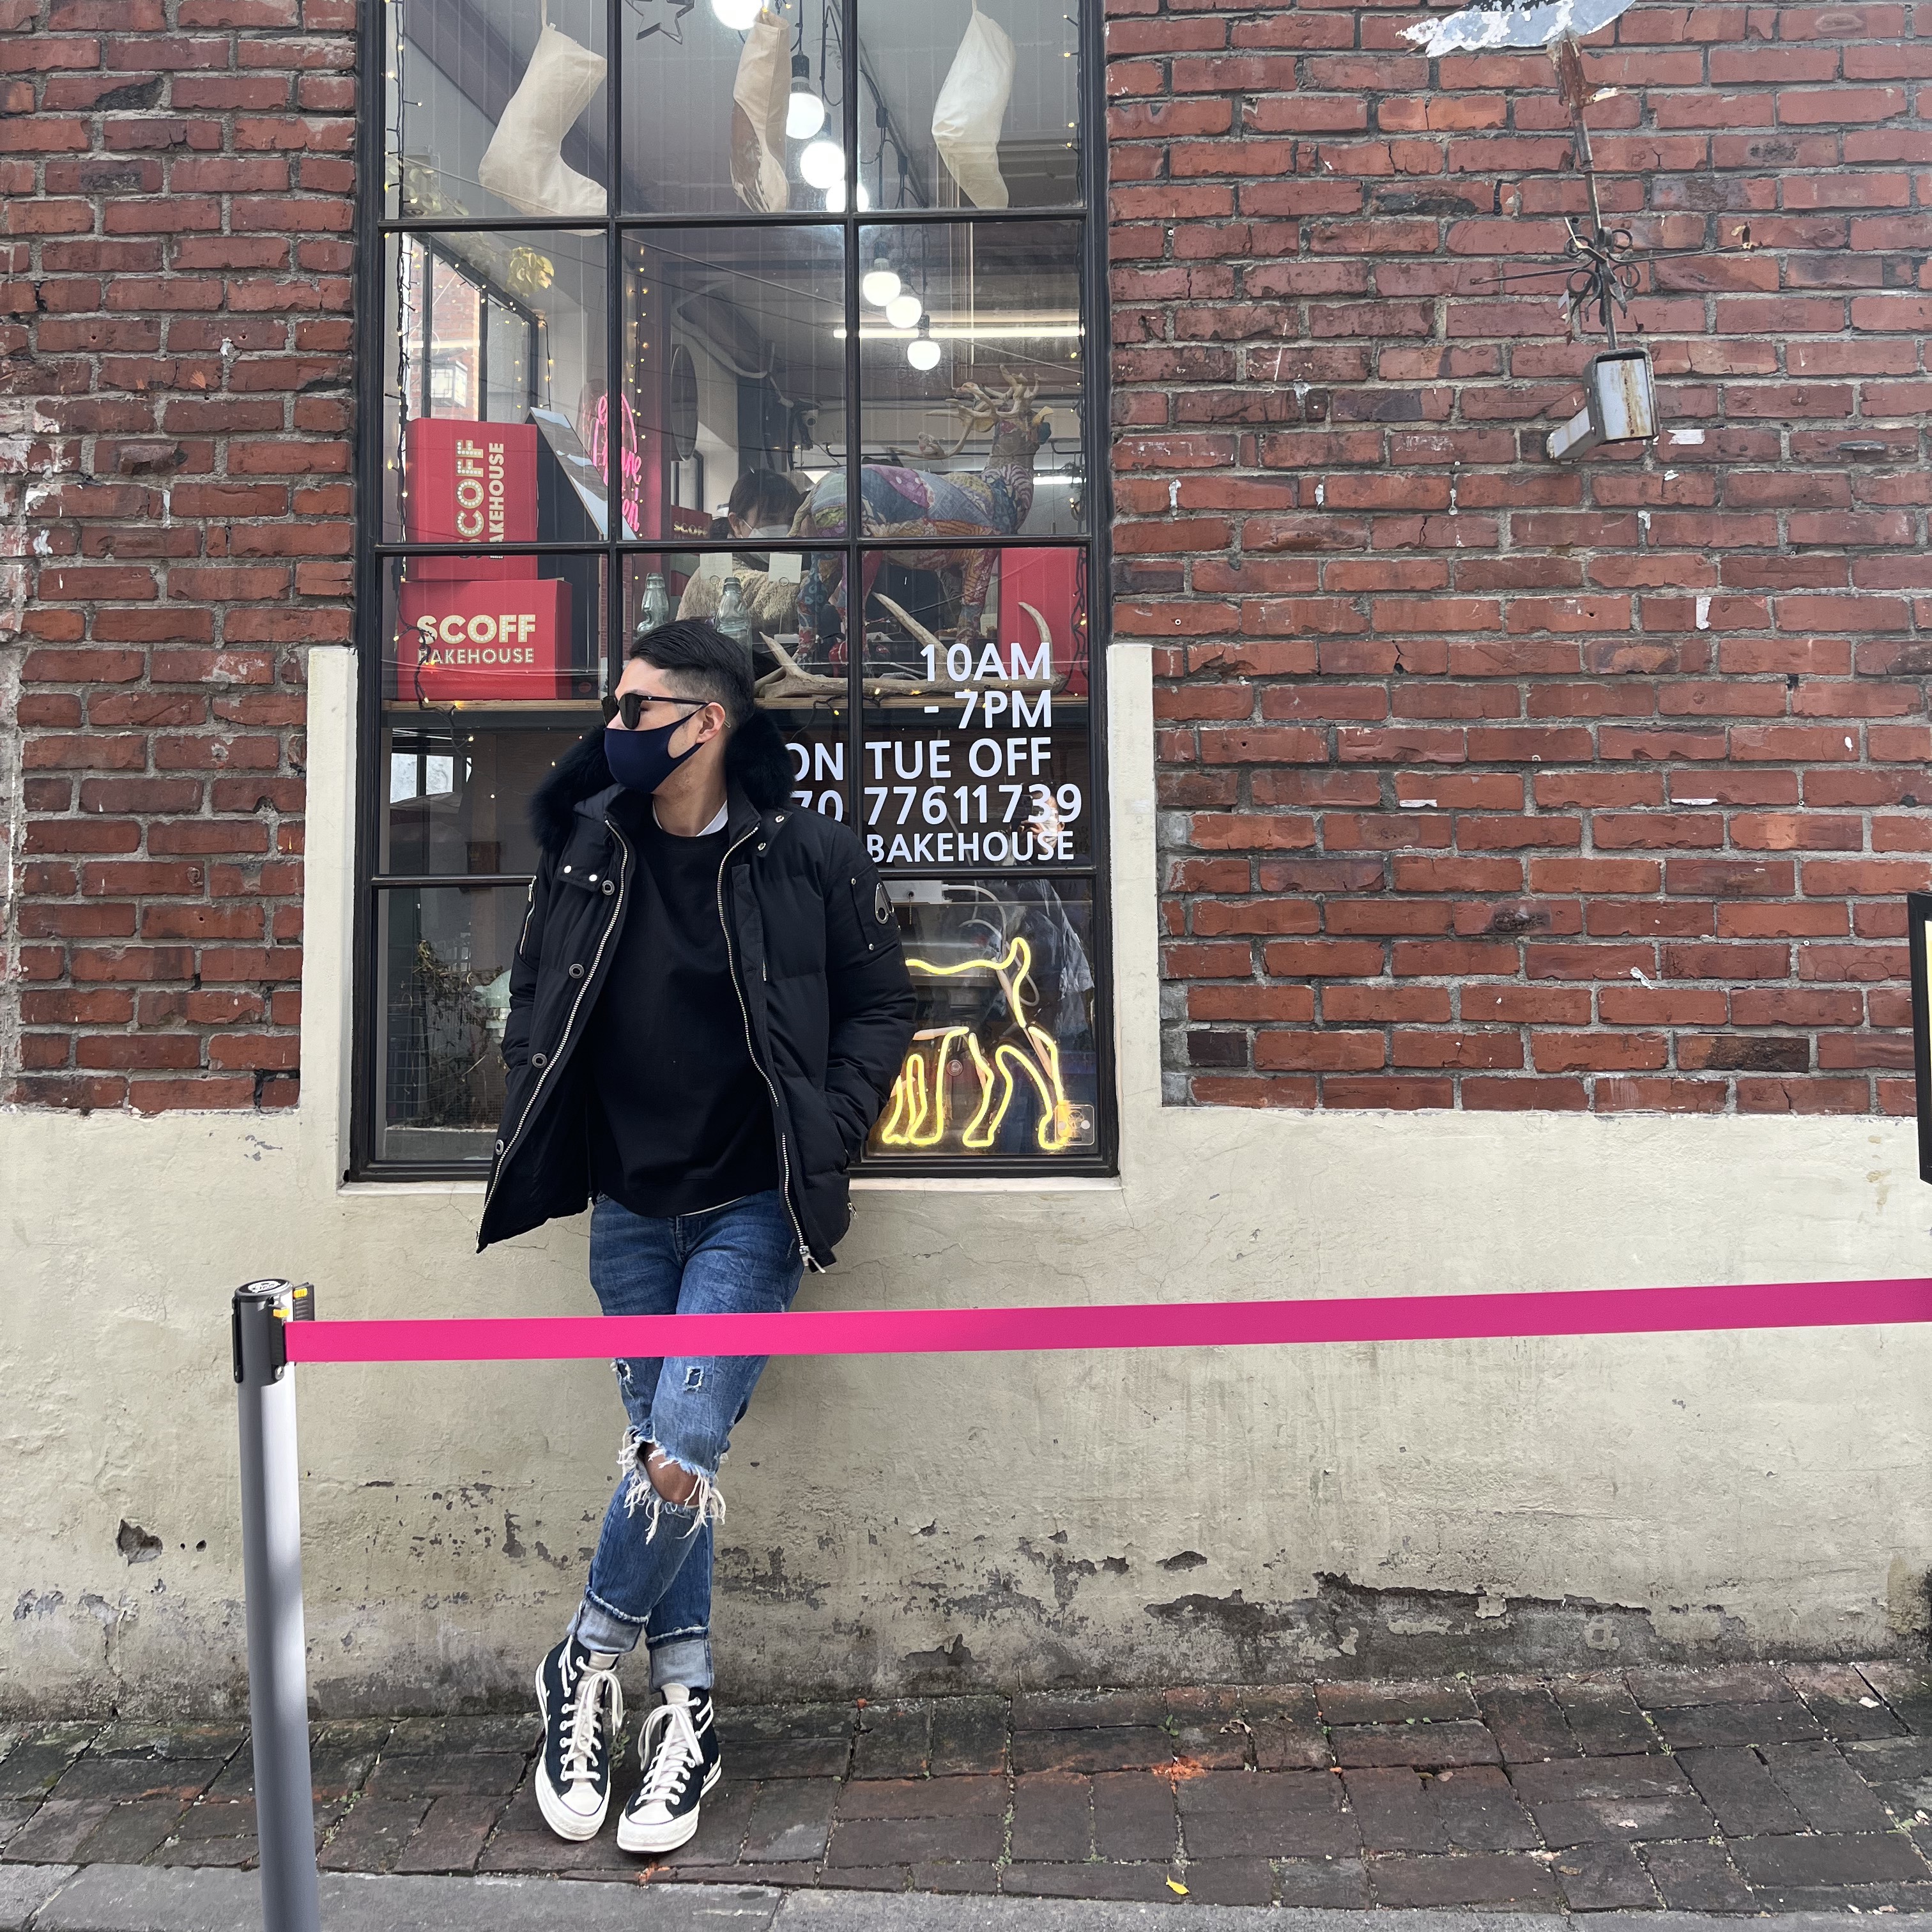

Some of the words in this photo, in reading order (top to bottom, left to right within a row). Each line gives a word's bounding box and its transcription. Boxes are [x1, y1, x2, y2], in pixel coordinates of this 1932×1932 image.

[456, 439, 484, 558] COFF
[488, 442, 505, 559] AKEHOUSE
[417, 614, 536, 645] SCOFF
[417, 647, 535, 665] BAKEHOUSE
[920, 642, 1050, 682] 10AM
[954, 689, 1052, 729] 7PM
[865, 739, 951, 779] TUE
[969, 737, 1052, 778] OFF
[864, 783, 1082, 825] 77611739
[866, 831, 1075, 862] BAKEHOUSE
